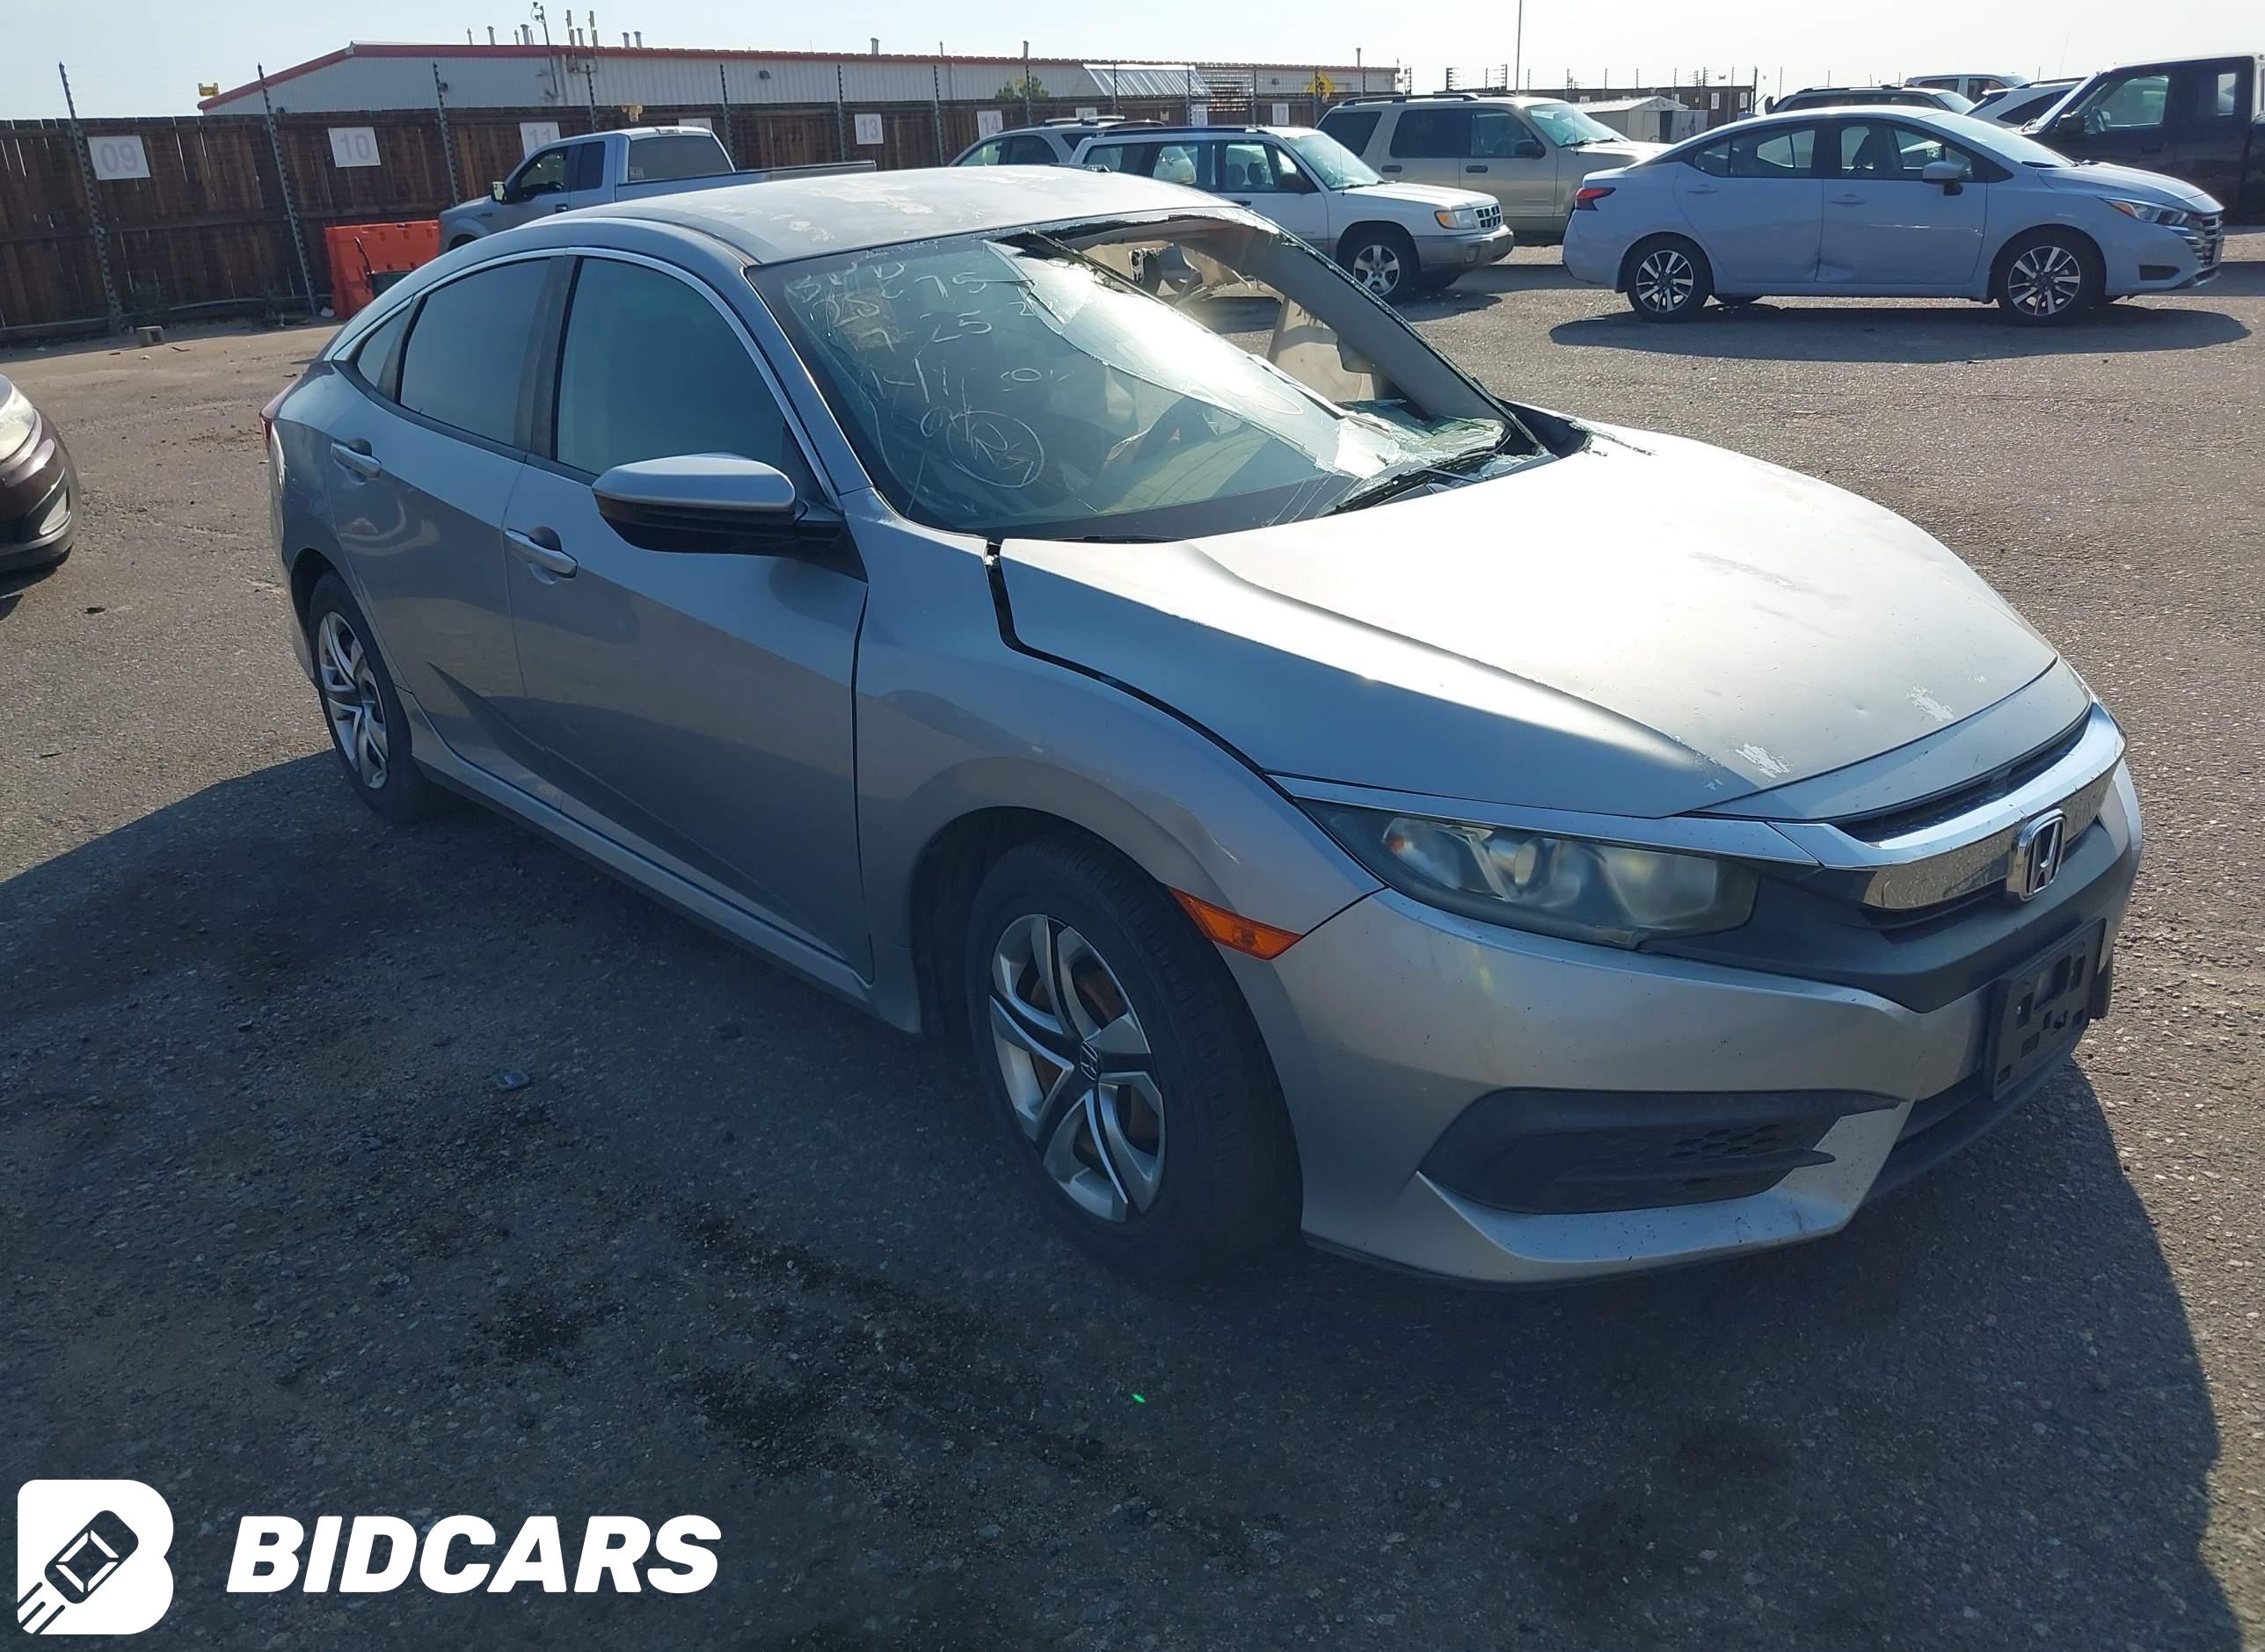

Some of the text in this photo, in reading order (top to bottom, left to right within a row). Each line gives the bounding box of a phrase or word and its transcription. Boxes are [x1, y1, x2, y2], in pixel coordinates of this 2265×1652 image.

[860, 119, 878, 139] 13
[982, 115, 1000, 135] 14
[100, 142, 139, 172] 09
[339, 133, 370, 160] 10
